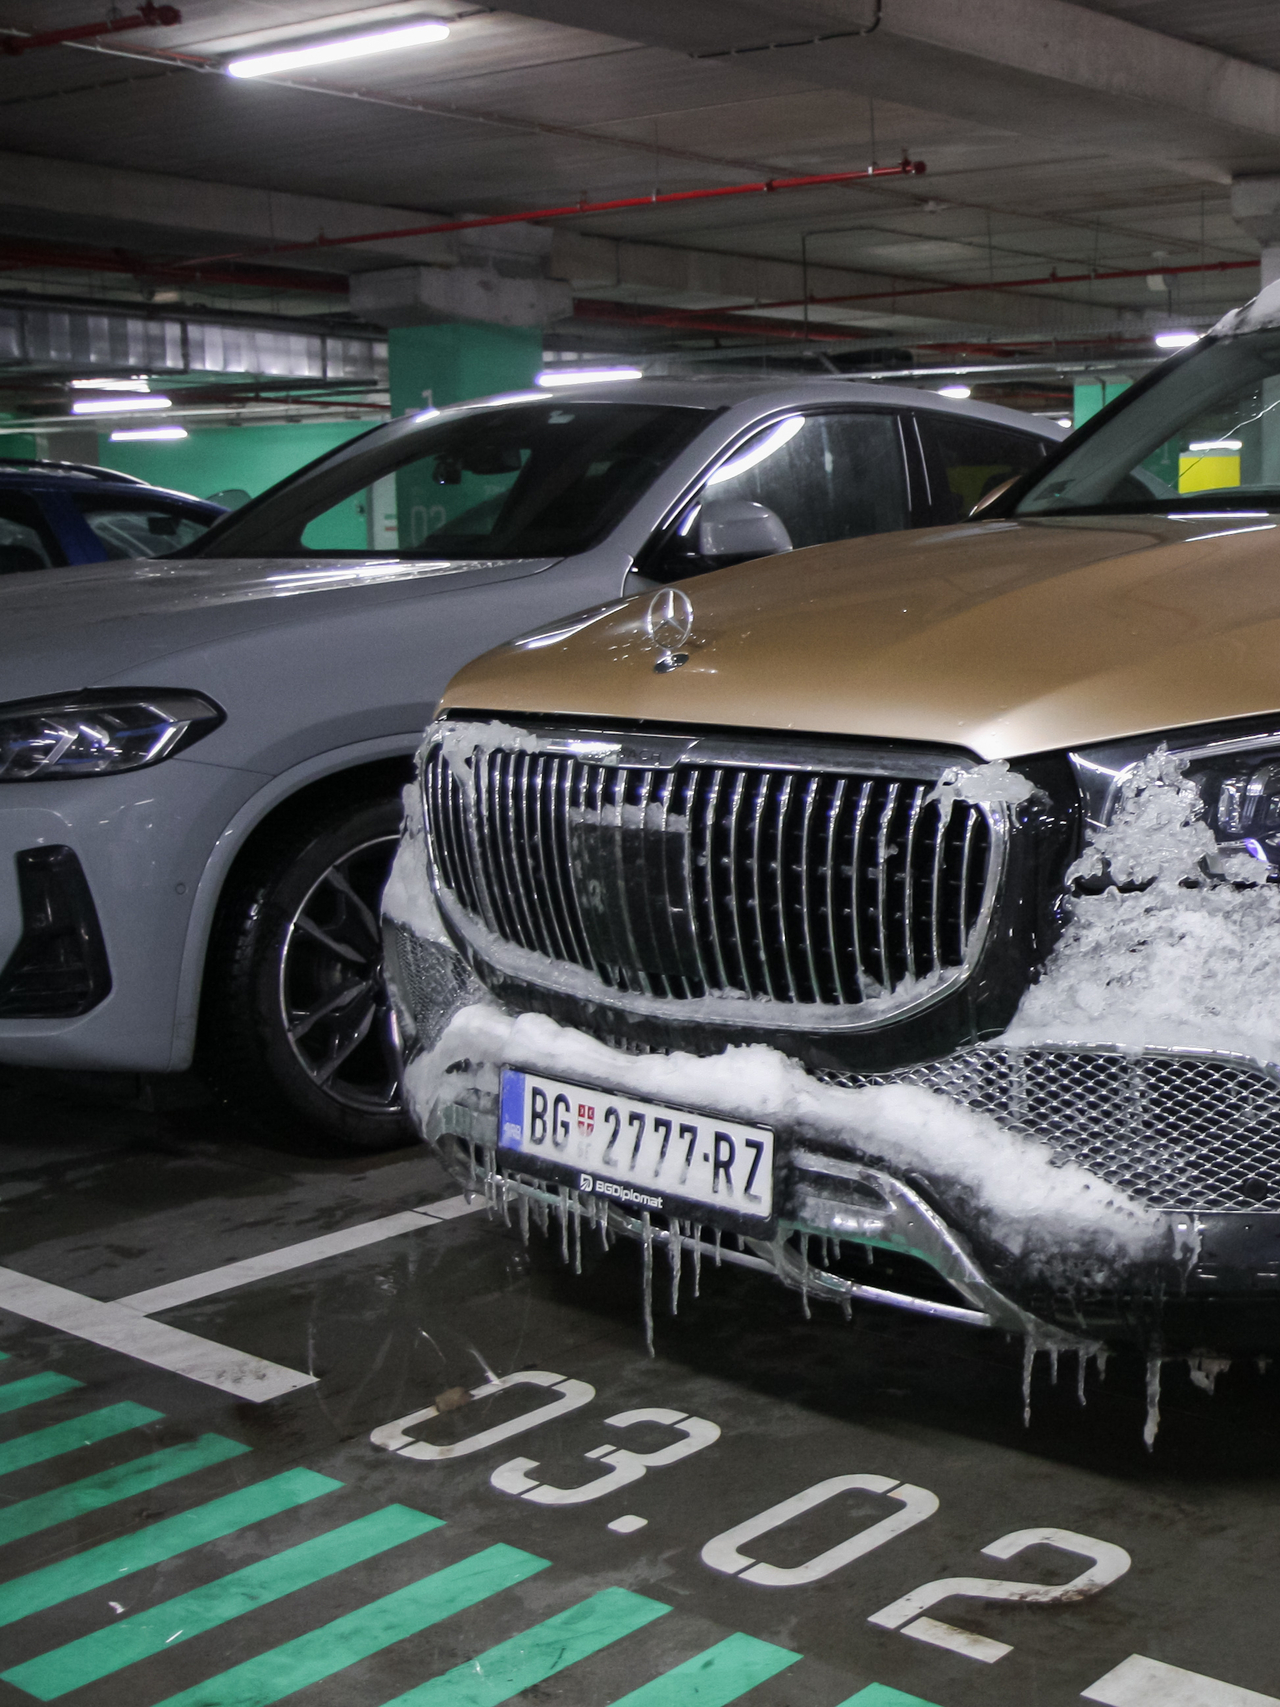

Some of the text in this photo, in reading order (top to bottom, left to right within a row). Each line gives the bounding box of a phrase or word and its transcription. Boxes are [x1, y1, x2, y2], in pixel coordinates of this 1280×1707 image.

[531, 1085, 571, 1151] BG
[595, 1180, 664, 1208] BGDiplomat
[370, 1370, 1131, 1663] 03.02
